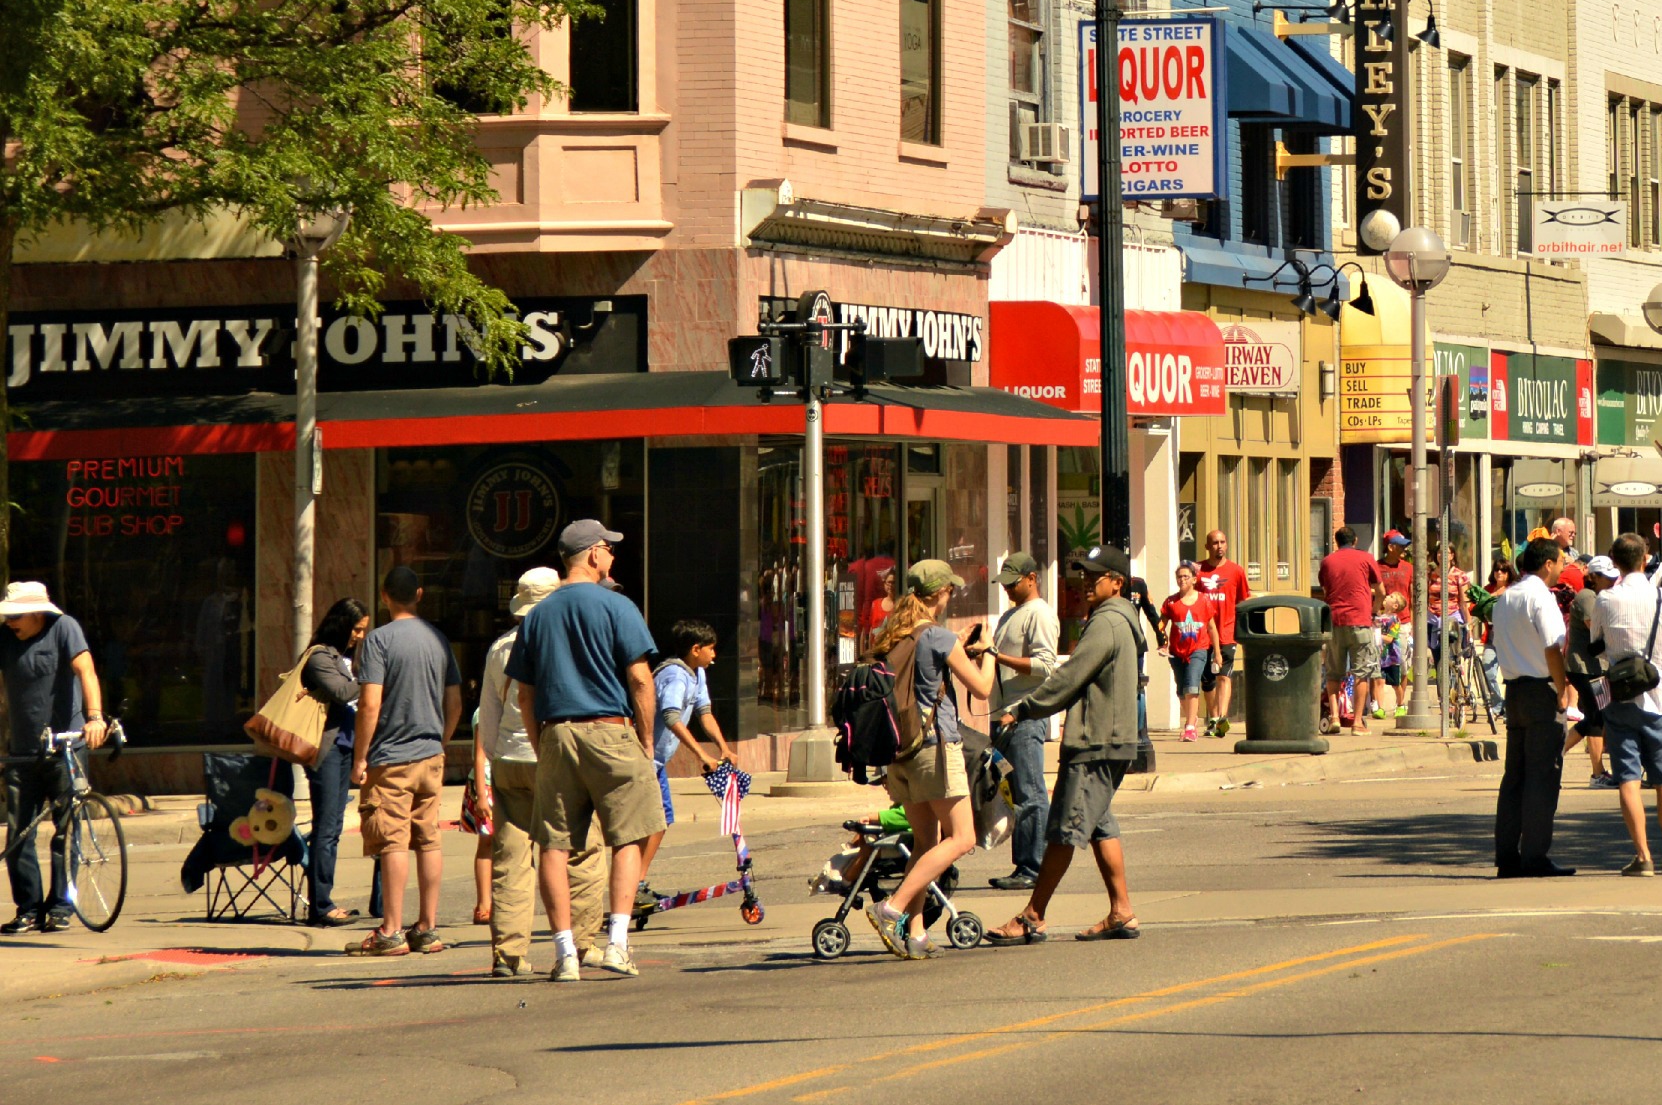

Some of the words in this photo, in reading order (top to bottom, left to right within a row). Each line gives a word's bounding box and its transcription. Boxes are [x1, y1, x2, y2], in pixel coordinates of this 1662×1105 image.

[1089, 27, 1138, 43] STE
[1143, 26, 1204, 41] STREET
[1088, 45, 1207, 106] LQUOR
[1119, 110, 1183, 123] ROCERY
[1089, 127, 1165, 141] IORTED
[1170, 125, 1210, 138] BEER
[1122, 144, 1199, 158] ER-WINE
[1121, 160, 1178, 174] LOTTO
[1537, 241, 1623, 254] orbithair.net
[7, 318, 275, 388] JIMMY
[1225, 345, 1274, 366] IRWAY
[1085, 358, 1102, 373] STAT
[1345, 362, 1367, 375] BUY
[1083, 378, 1102, 394] STREE
[1126, 351, 1193, 406] QUOR
[1346, 379, 1369, 392] SELL
[1347, 397, 1382, 409] TRADE
[1517, 377, 1568, 420] BIVOUAC
[66, 457, 184, 481] PREMIUM
[66, 486, 182, 509] GOURMET
[67, 515, 114, 538] SUB
[119, 514, 184, 537] SHOP
